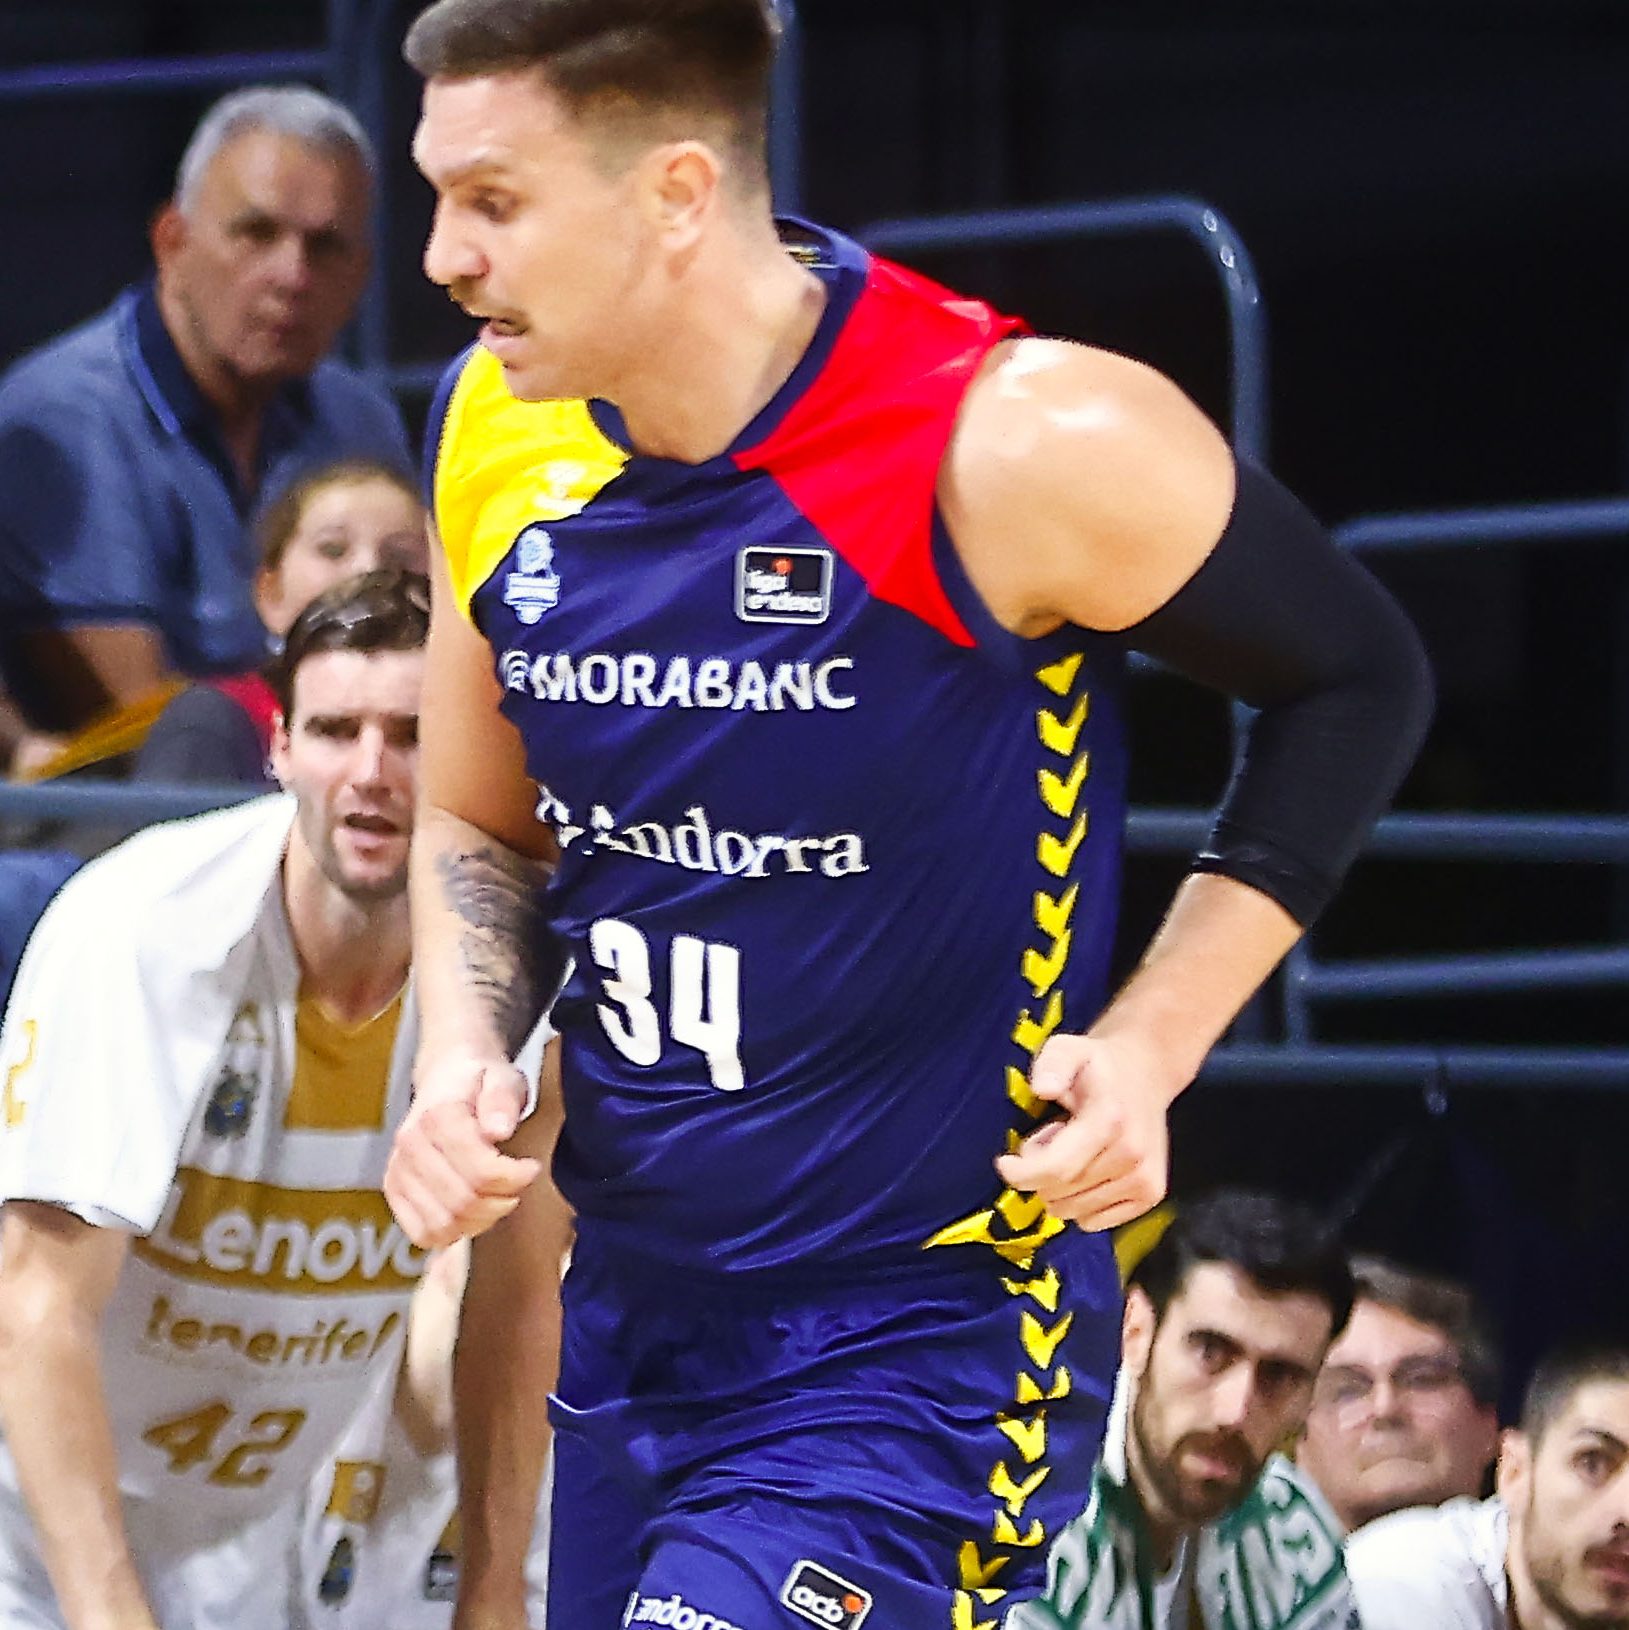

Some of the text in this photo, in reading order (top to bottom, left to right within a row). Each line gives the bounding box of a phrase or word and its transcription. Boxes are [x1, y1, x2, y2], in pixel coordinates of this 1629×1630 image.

[590, 917, 746, 1091] 34
[143, 1401, 309, 1488] 42
[791, 1585, 845, 1624] acb
